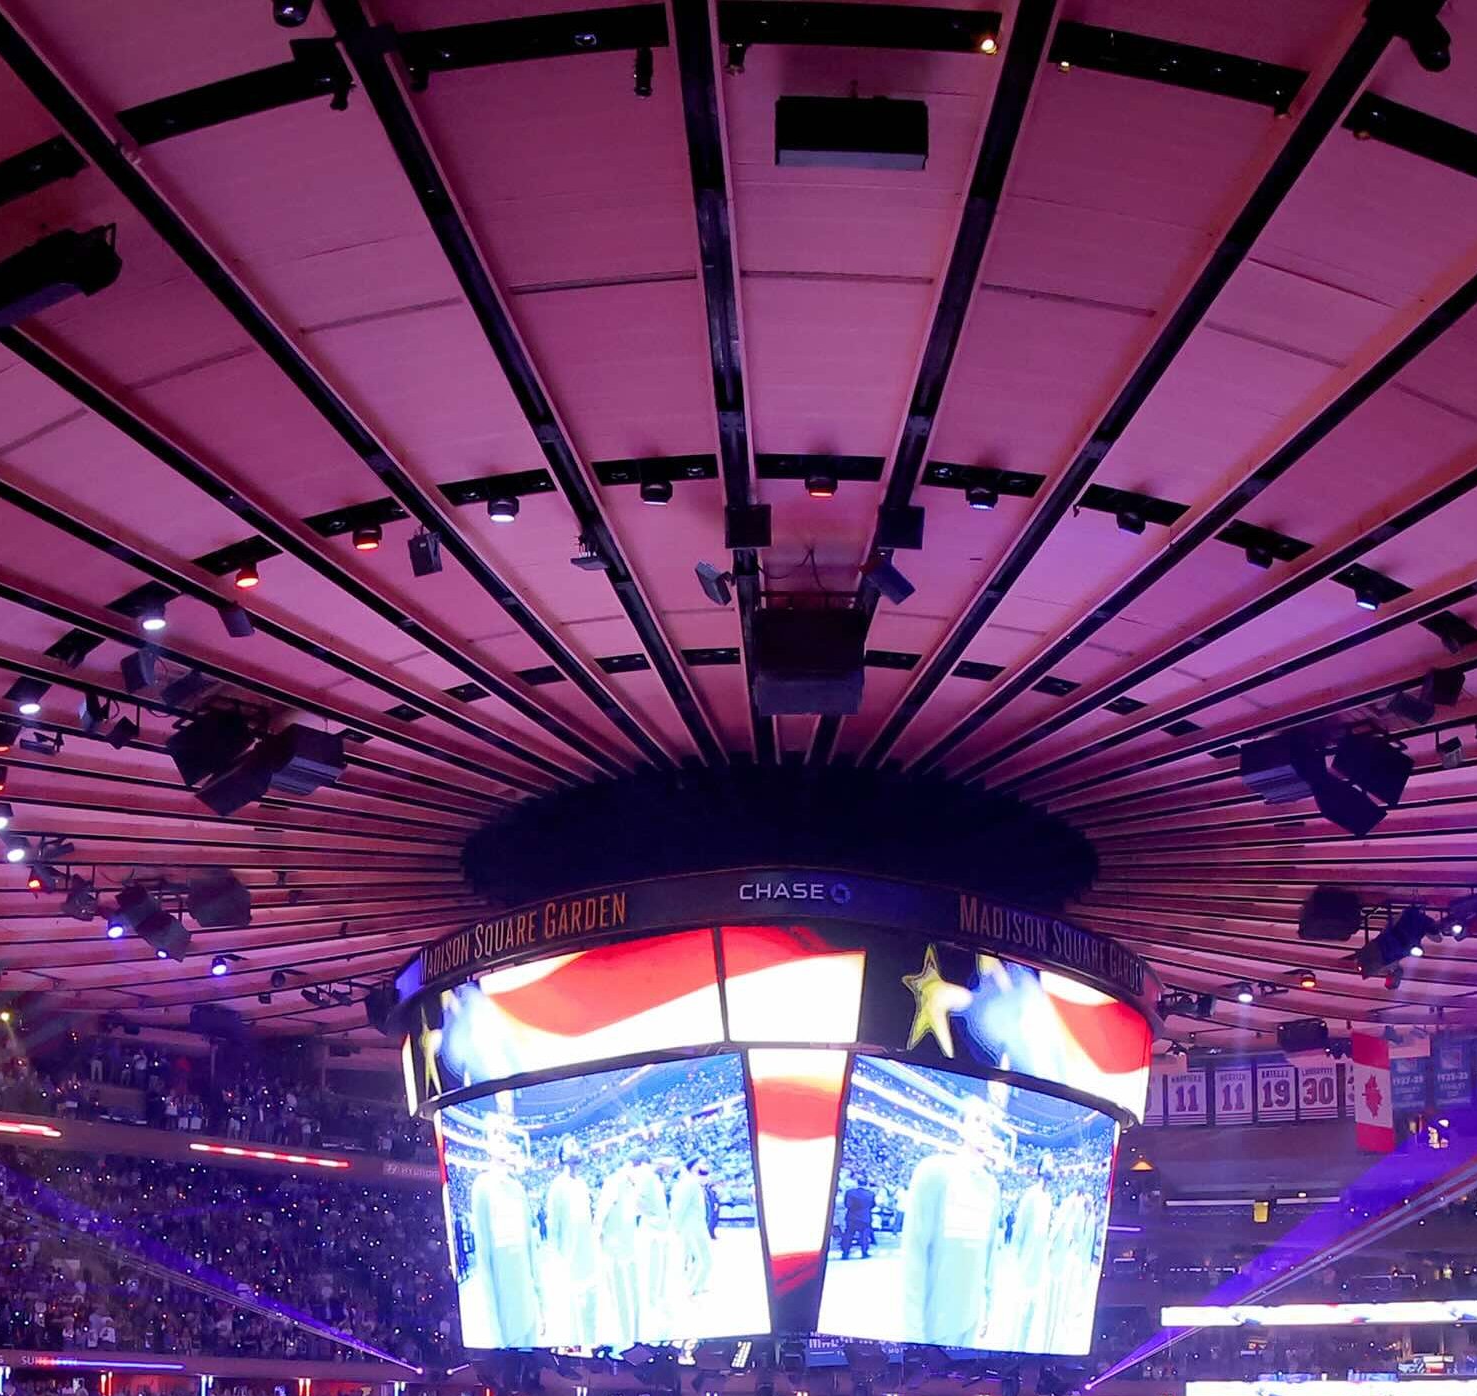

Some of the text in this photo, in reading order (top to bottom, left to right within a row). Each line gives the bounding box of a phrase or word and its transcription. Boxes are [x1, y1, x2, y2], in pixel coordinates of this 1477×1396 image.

[739, 883, 824, 900] CHASE
[474, 910, 537, 959] SQUARE
[544, 892, 626, 939] GARDEN
[959, 895, 1047, 950] MADISON
[1052, 920, 1106, 973] SQUARE
[1175, 1085, 1199, 1112] 11
[1222, 1083, 1245, 1111] 11
[1262, 1080, 1290, 1108] 19
[1302, 1077, 1334, 1105] 30
